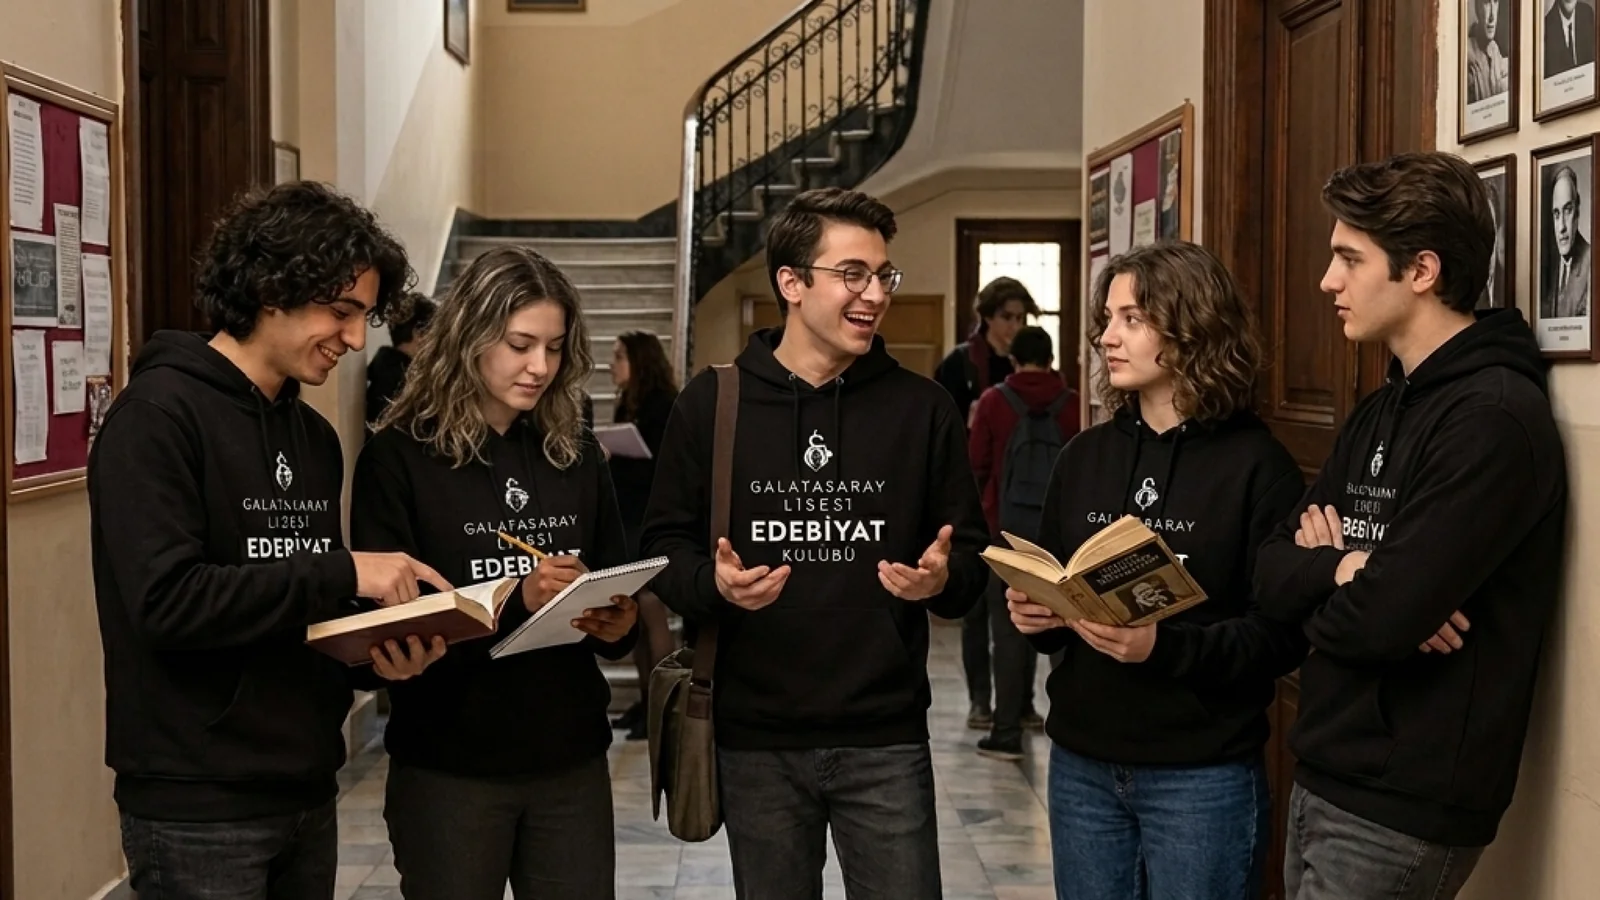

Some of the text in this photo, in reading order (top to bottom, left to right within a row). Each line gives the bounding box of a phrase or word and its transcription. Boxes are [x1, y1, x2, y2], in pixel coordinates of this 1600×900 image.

[750, 480, 885, 493] GALATASARAY
[751, 515, 885, 542] EDEBİYAT
[470, 549, 581, 579] EDEB
